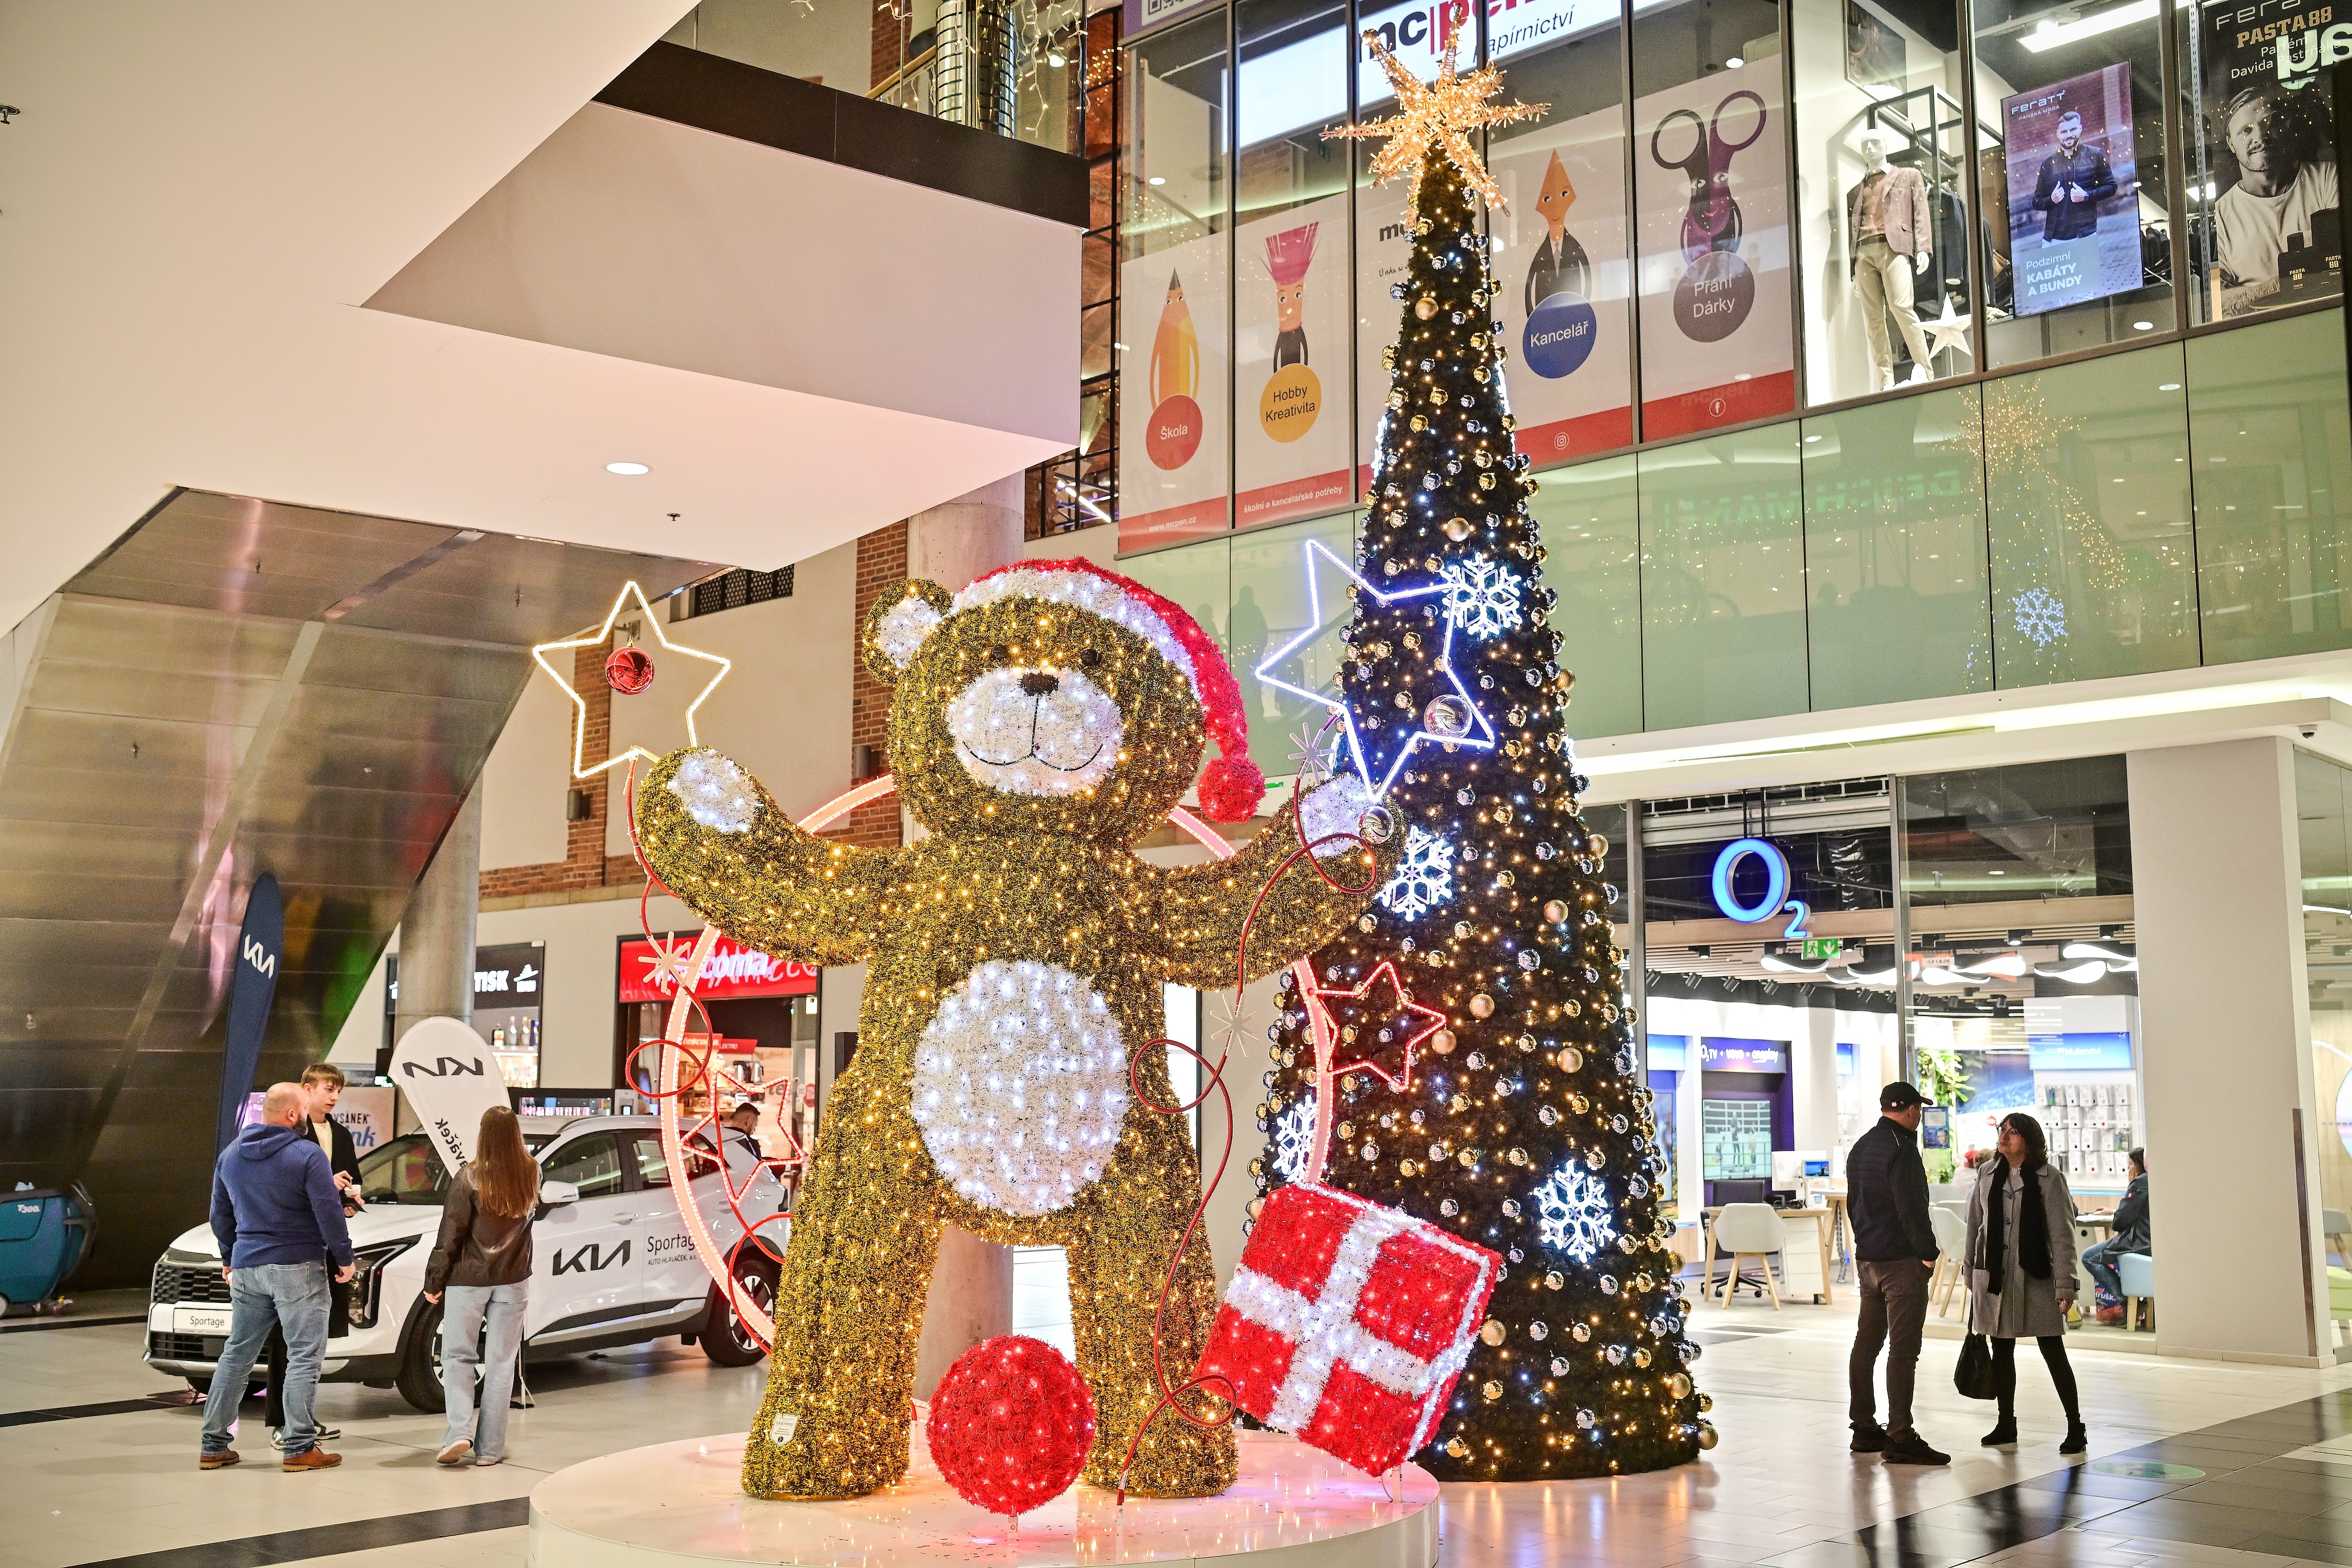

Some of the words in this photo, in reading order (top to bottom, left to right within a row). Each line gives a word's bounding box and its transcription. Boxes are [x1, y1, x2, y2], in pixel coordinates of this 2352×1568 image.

[1473, 5, 1575, 63] apírnictví
[2237, 14, 2306, 48] PASTA
[2308, 6, 2332, 27] 88
[2231, 59, 2273, 79] Davida
[2026, 251, 2071, 270] Podzimní
[2027, 262, 2077, 284] KABÁTY
[1694, 274, 1732, 297] Přání
[2027, 286, 2037, 297] A
[2039, 273, 2082, 294] BUNDY
[1693, 297, 1736, 318] Dárky
[1530, 320, 1589, 348] Kancelář
[1273, 386, 1308, 403] Hobby
[1265, 402, 1315, 422] Kreativita
[1160, 424, 1188, 440] Škola
[1243, 501, 1264, 513] školní
[1315, 485, 1343, 499] potřeby
[1149, 517, 1197, 533] www.mcpen.cz
[647, 1234, 695, 1255] Sportag
[552, 1240, 631, 1276] KIA
[190, 1316, 224, 1328] Sportage
